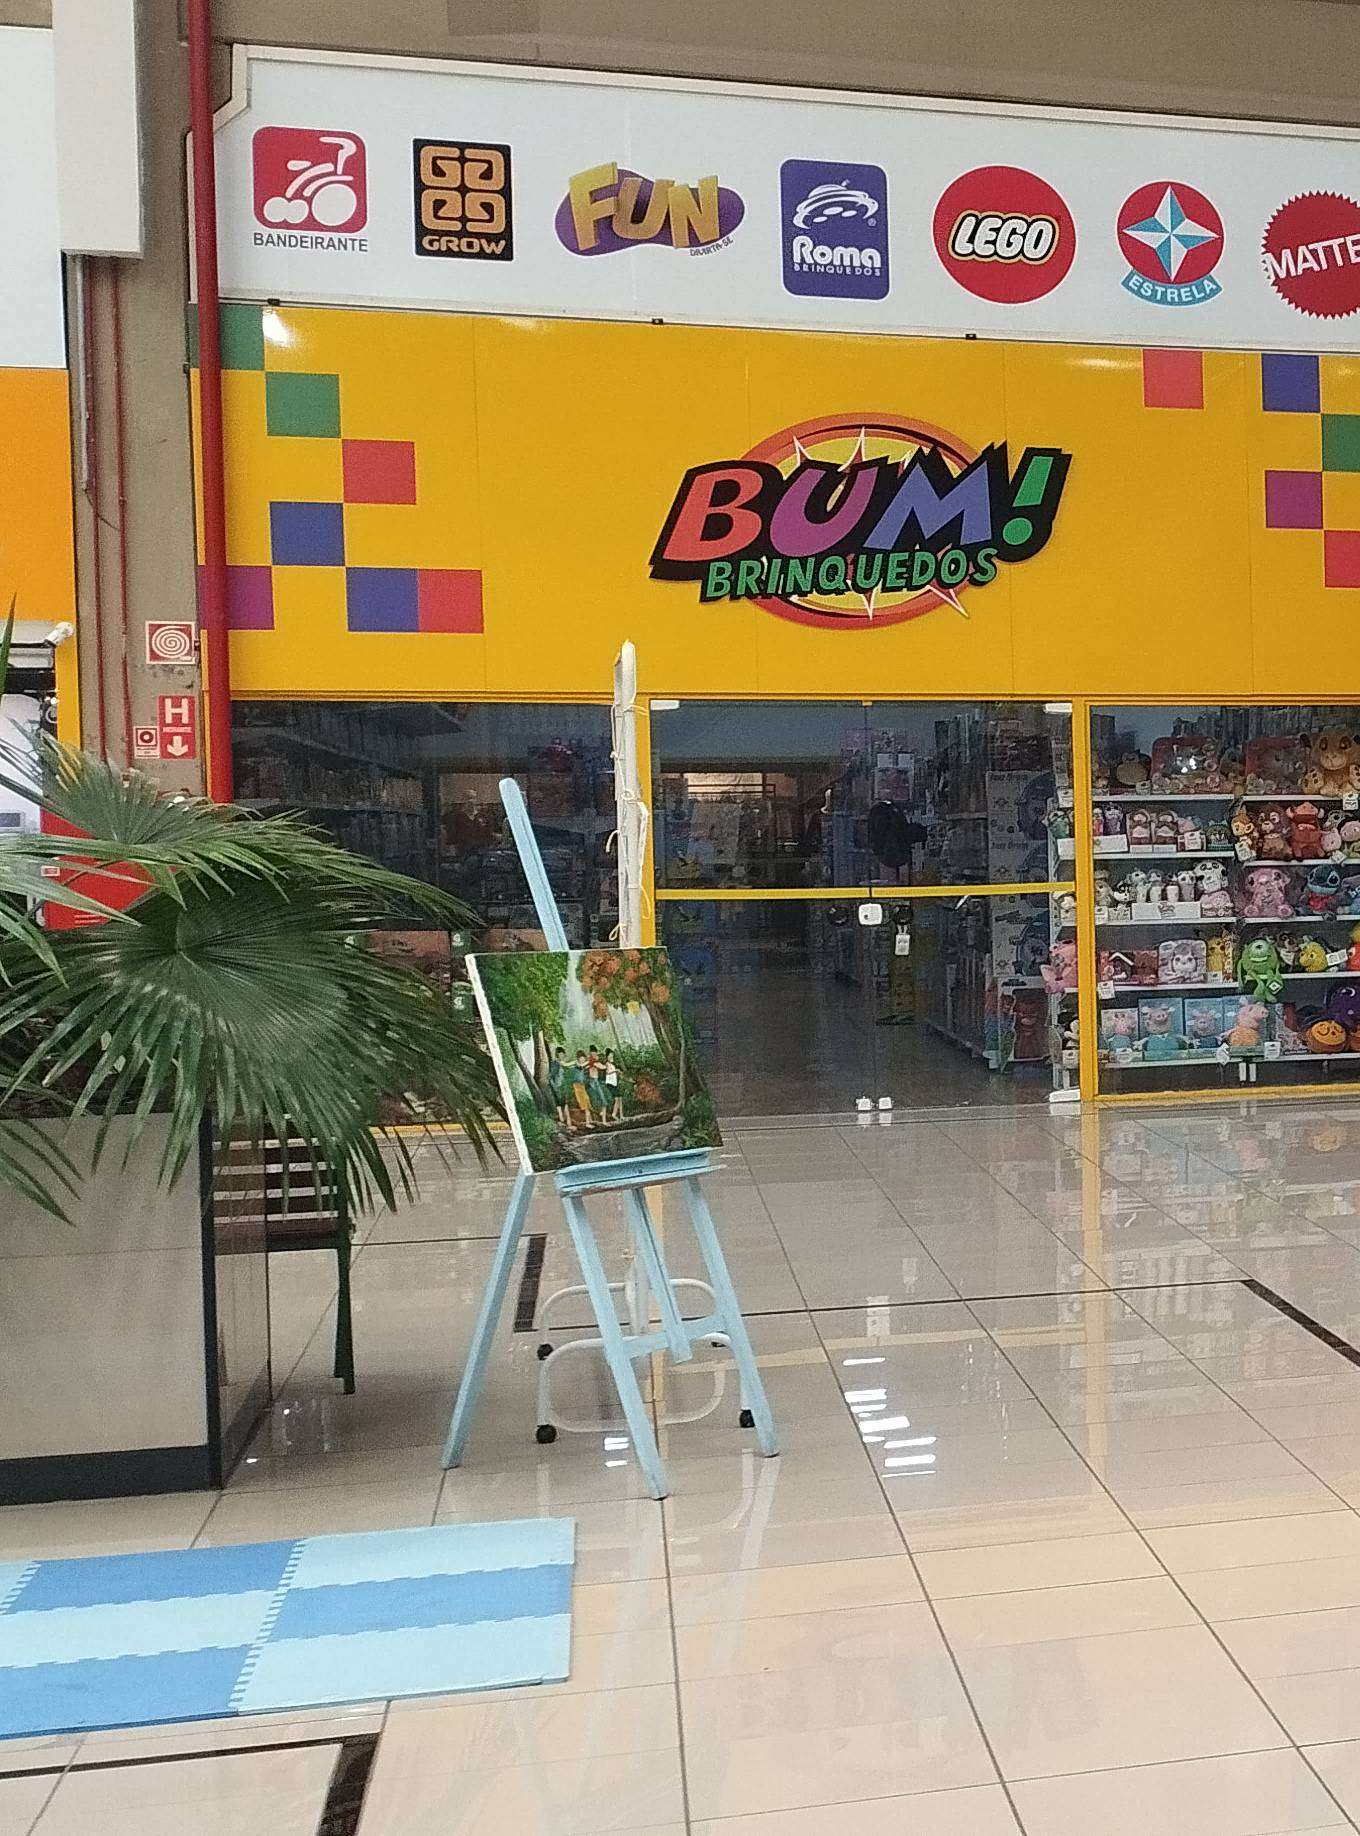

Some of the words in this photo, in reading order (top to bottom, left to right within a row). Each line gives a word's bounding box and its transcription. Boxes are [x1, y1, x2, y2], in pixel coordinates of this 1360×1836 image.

[569, 161, 720, 250] FUN
[253, 232, 369, 252] BANDEIRANTE
[422, 235, 506, 254] GROW
[793, 235, 881, 268] Roma
[951, 213, 1056, 262] LEGO
[794, 263, 881, 277] BRINQUEDOS
[1127, 274, 1217, 302] ESTRELA
[658, 450, 1060, 568] BUM!
[705, 548, 999, 599] BRINQUEDOS
[164, 697, 190, 724] H
